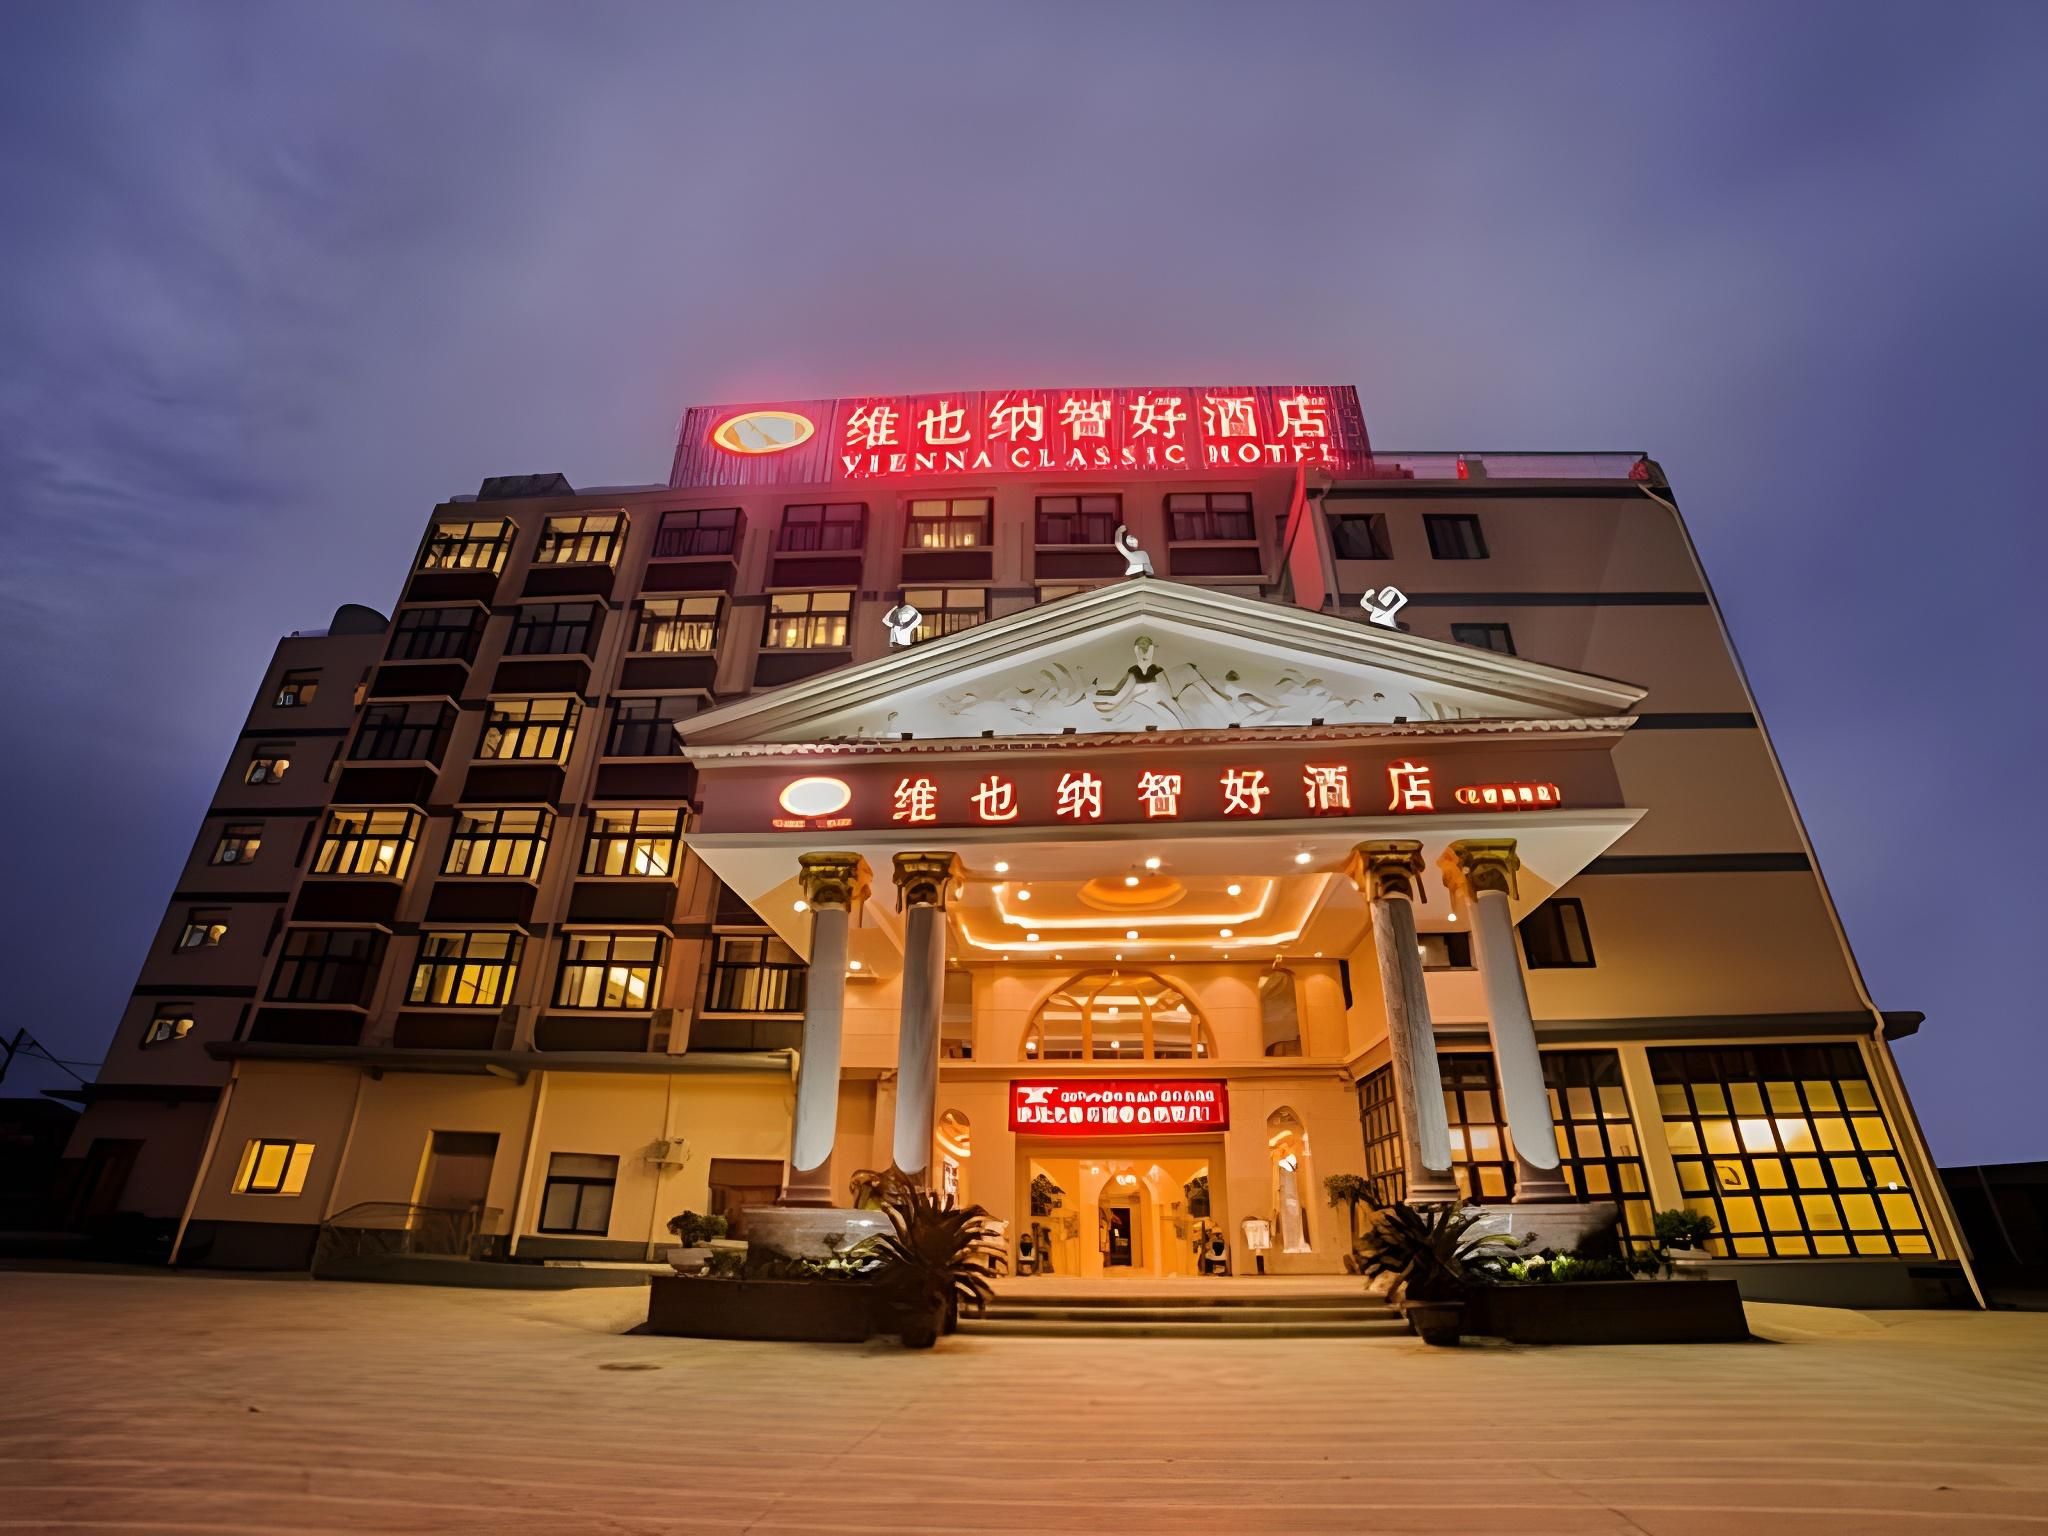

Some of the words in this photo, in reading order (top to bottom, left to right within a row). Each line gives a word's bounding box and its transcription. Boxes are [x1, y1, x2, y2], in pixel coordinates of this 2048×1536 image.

[846, 394, 1326, 448] 维也纳智好酒店
[842, 449, 992, 477] VIENNA
[1011, 444, 1186, 472] CLASSIC
[893, 762, 1435, 823] 维也纳智好酒店
